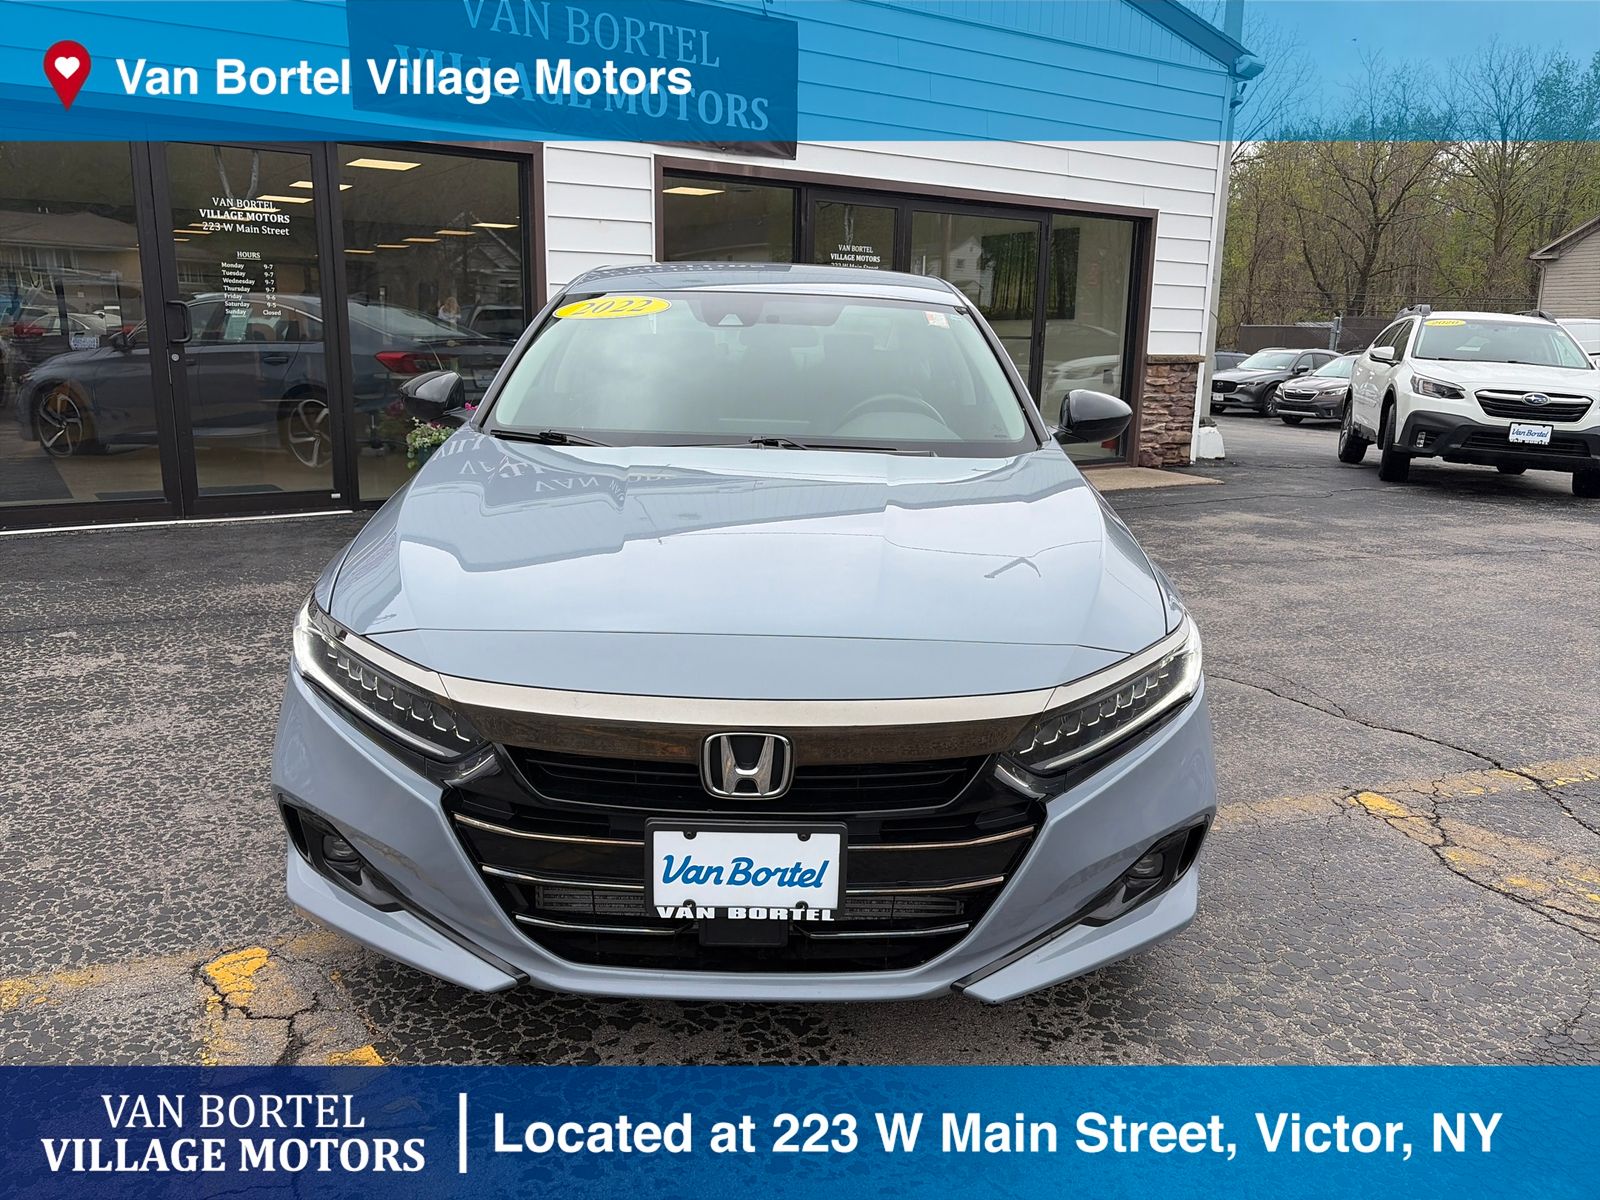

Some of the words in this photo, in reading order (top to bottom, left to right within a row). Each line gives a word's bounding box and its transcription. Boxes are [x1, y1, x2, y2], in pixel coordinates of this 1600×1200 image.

[461, 0, 551, 40] VAN
[566, 6, 720, 68] BORTEL
[212, 197, 233, 207] VAN
[236, 199, 276, 210] BORTEL
[199, 209, 243, 220] VILLAGE
[246, 213, 290, 223] MOTORS
[202, 221, 221, 231] 223
[223, 223, 233, 232] W
[236, 224, 259, 234] Main
[261, 226, 290, 236] Street
[236, 251, 261, 259] HOURS
[851, 245, 874, 253] BORTEL
[830, 253, 855, 261] VILLAGE
[223, 285, 250, 293] Thursday
[571, 300, 652, 315] 2022
[656, 905, 716, 920] VAN
[728, 906, 835, 921] BORTEL
